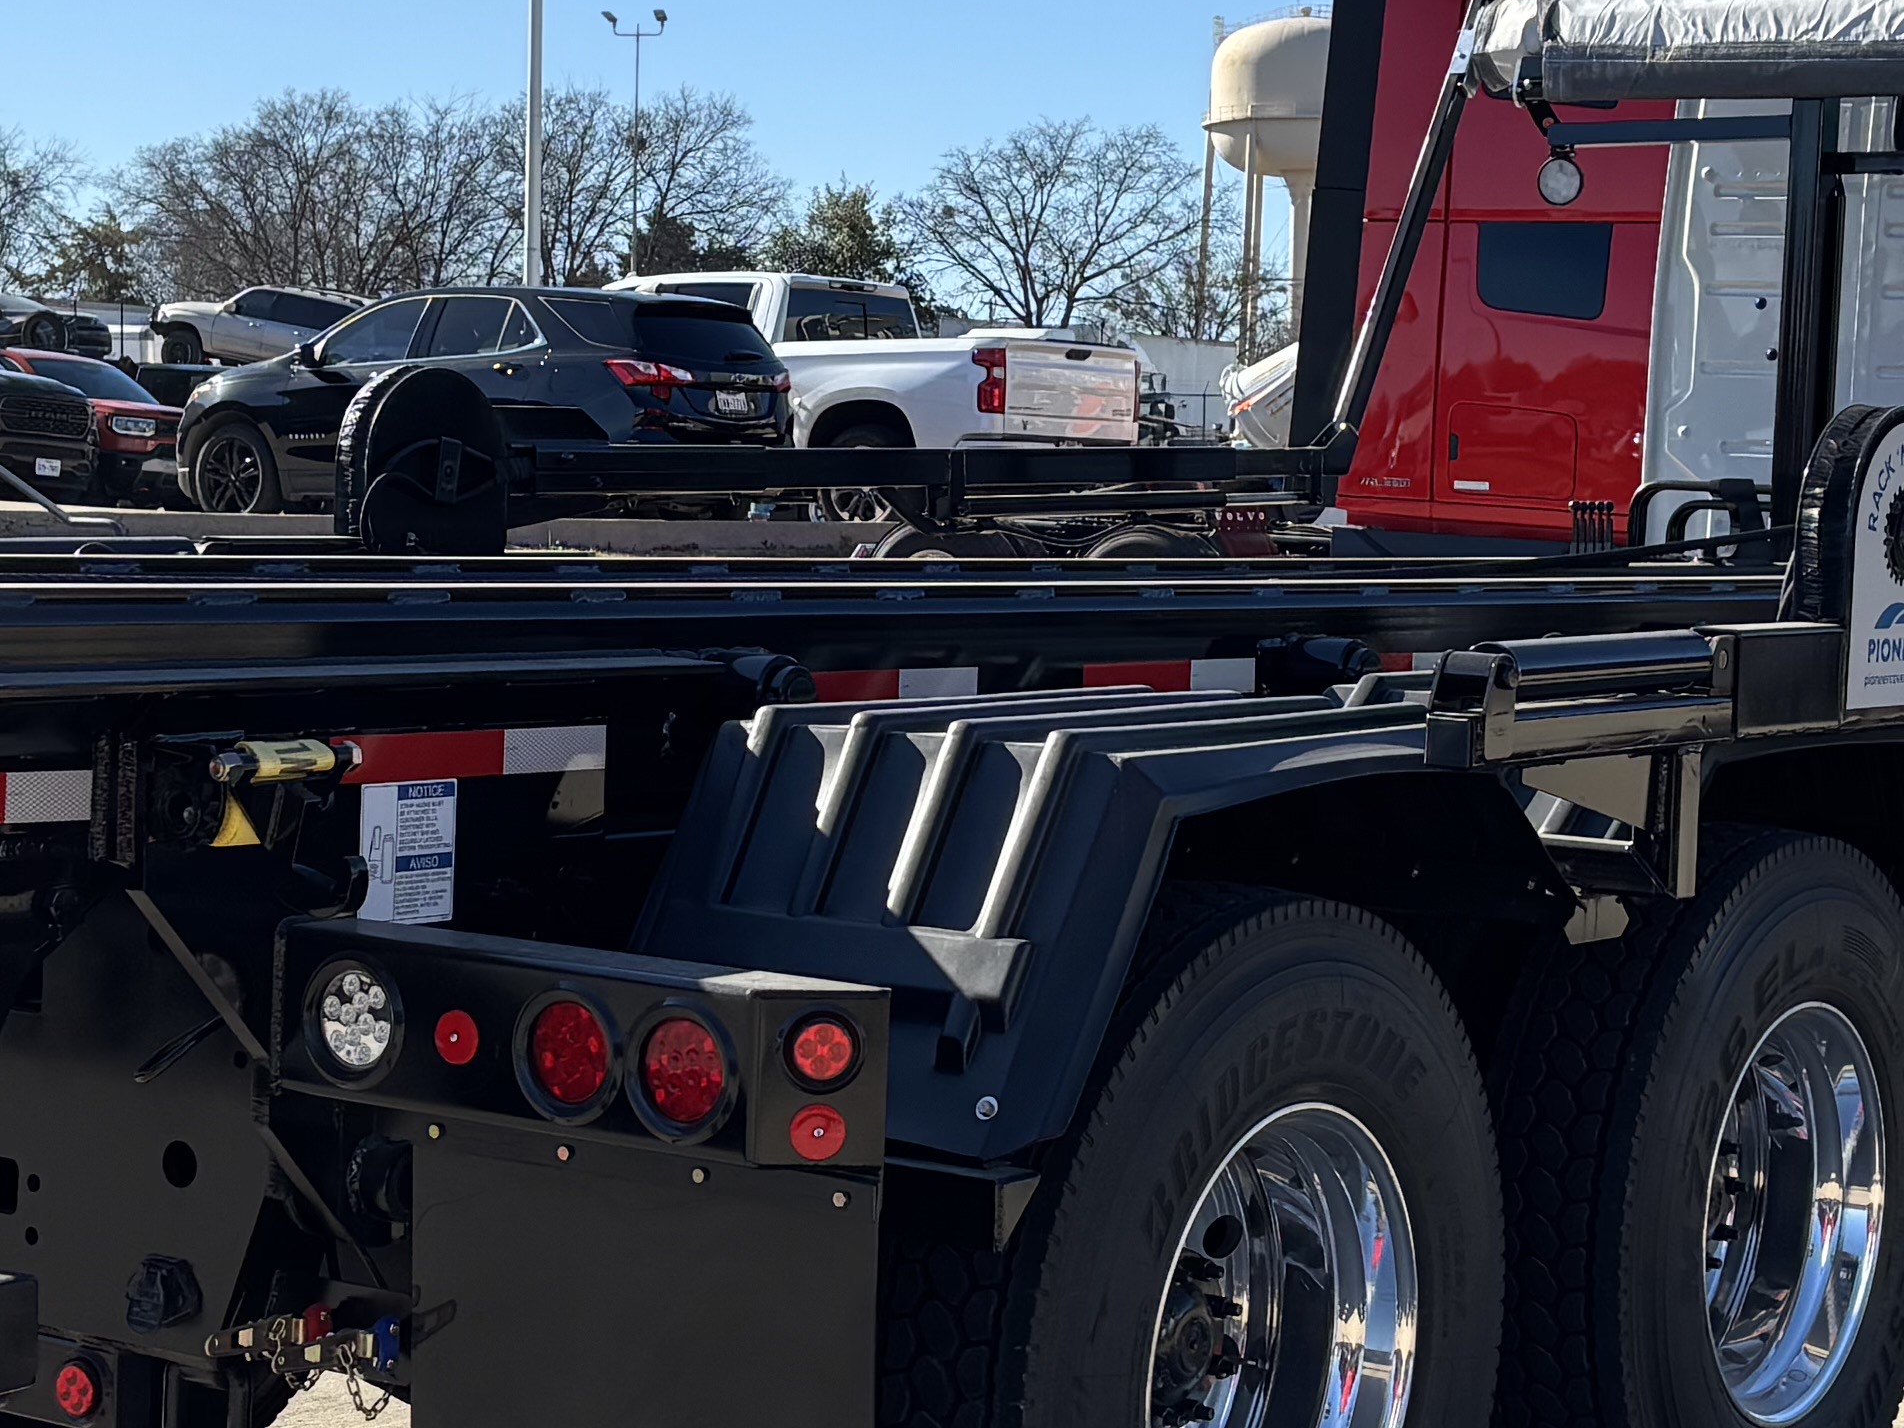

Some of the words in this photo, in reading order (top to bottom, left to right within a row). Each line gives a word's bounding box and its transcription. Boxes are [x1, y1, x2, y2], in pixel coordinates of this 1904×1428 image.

[1868, 453, 1896, 532] RACK
[1214, 510, 1265, 522] VOLVO
[408, 784, 446, 798] NOTICE
[409, 855, 439, 870] AVISO
[1141, 1009, 1427, 1260] BRIDGESTONE
